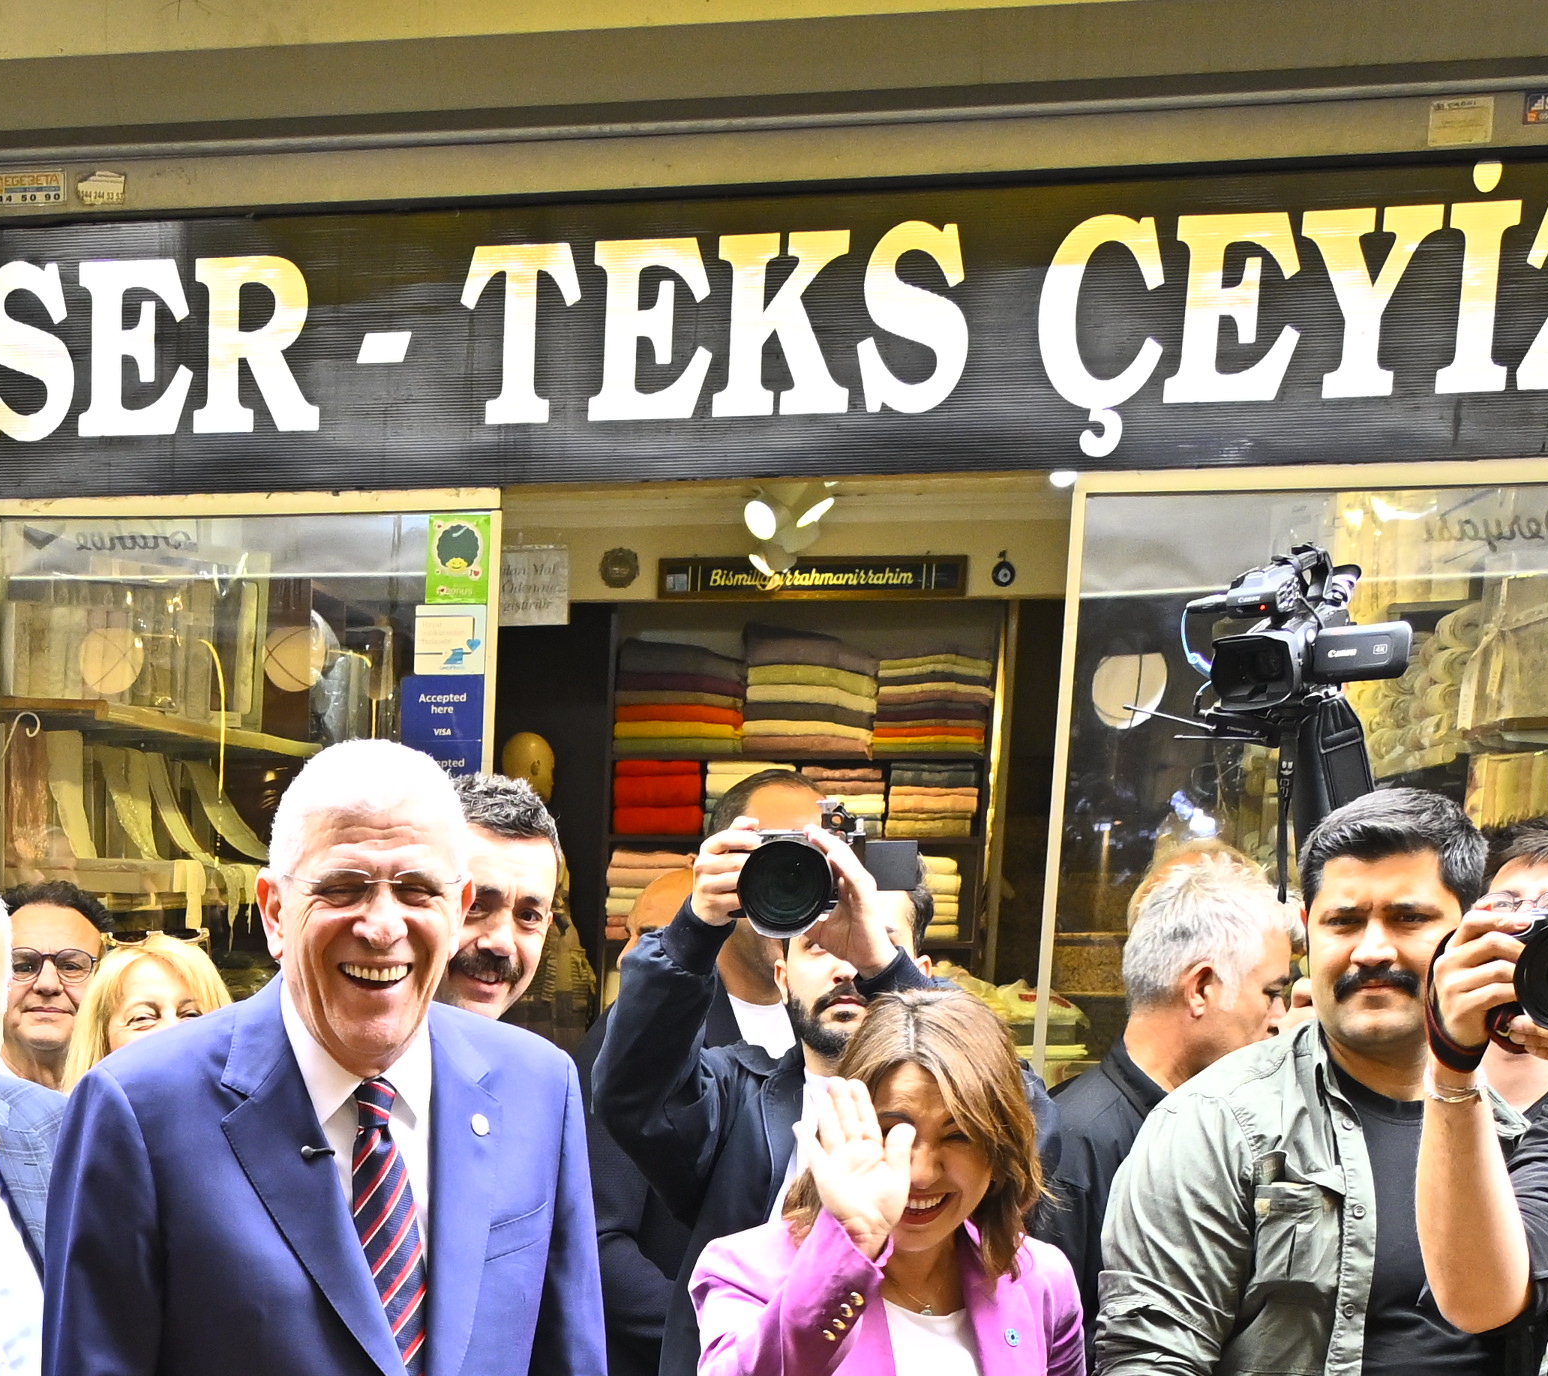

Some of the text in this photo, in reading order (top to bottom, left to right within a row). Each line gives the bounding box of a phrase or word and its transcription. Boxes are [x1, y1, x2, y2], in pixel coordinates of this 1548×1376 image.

[21, 193, 37, 202] 50
[44, 193, 61, 201] 90
[460, 221, 968, 426] TEKS
[1238, 595, 1261, 603] Canon
[1327, 648, 1357, 658] Canon
[418, 692, 467, 704] Accepted
[431, 705, 454, 714] here
[433, 728, 452, 736] VISA
[437, 758, 465, 769] epted
